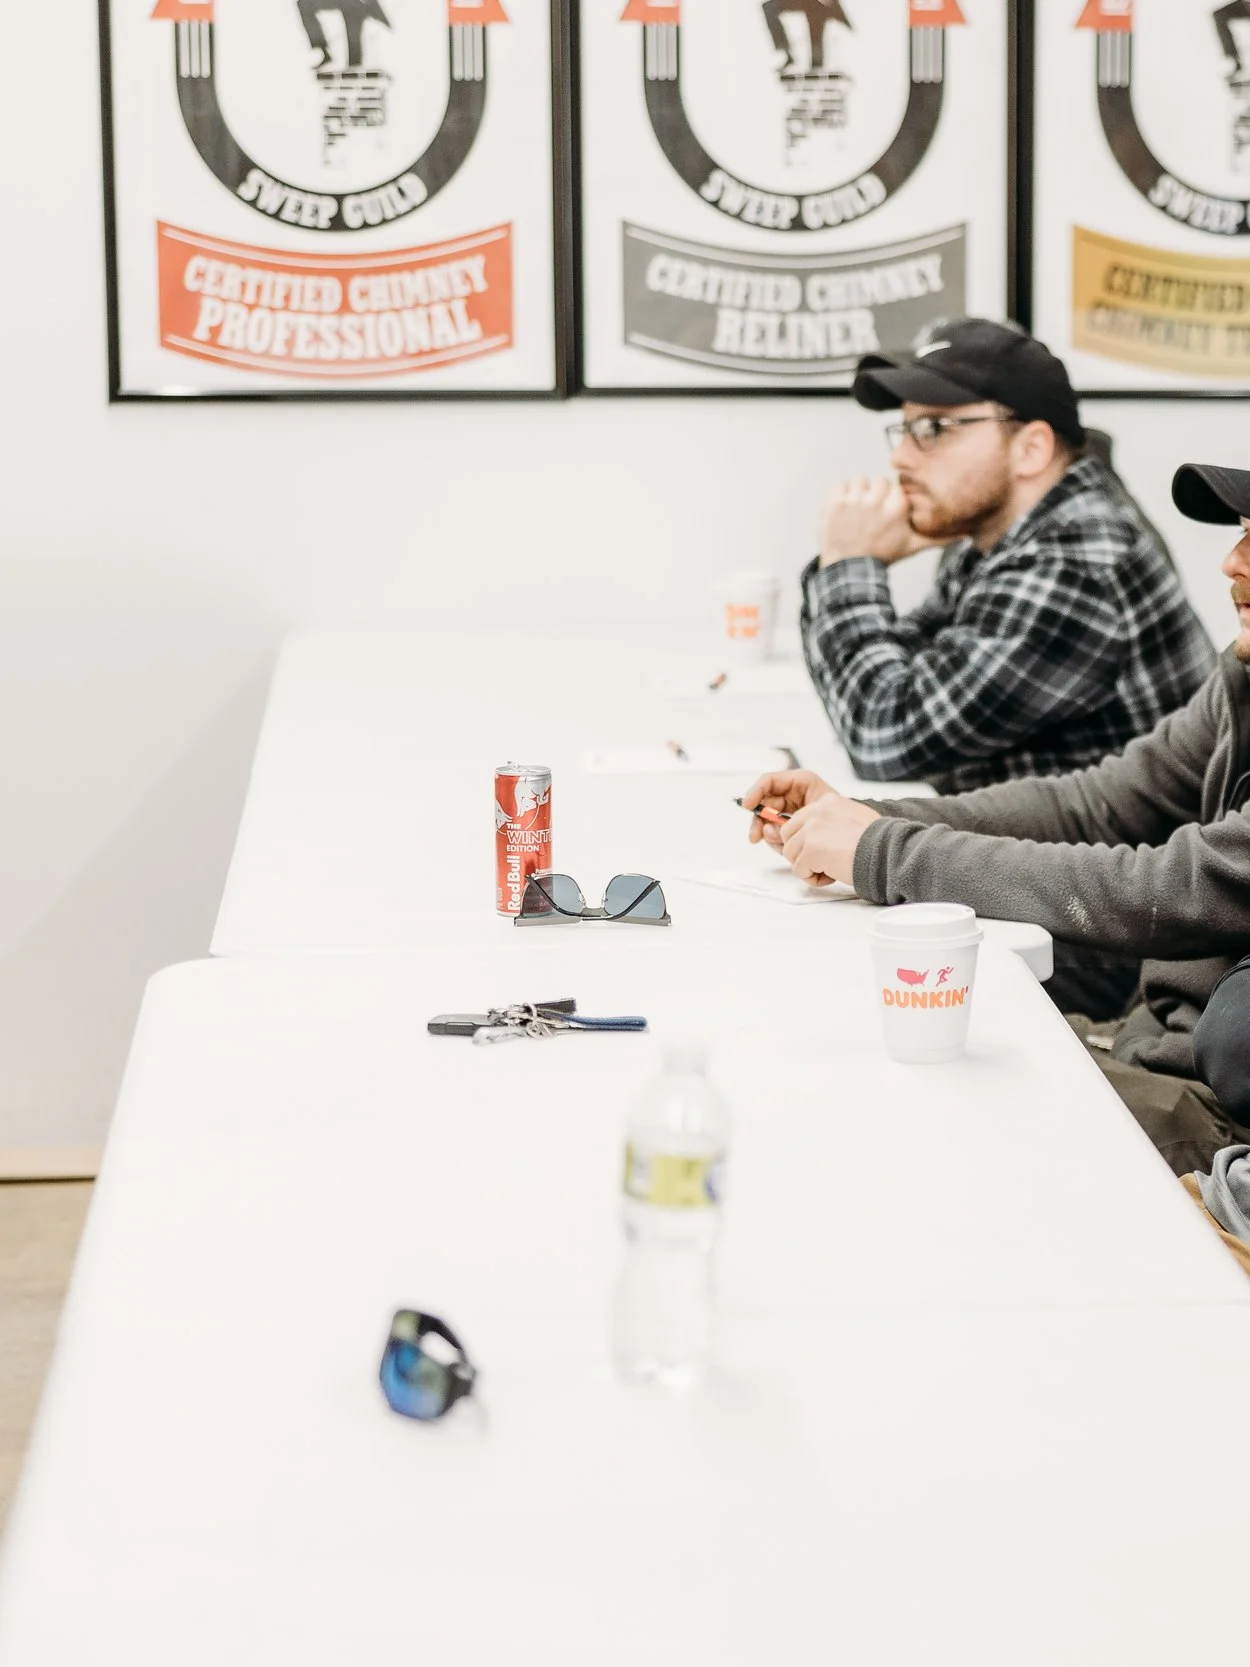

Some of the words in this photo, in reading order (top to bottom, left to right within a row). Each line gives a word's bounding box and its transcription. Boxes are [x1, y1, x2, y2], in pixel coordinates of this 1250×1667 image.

[238, 168, 338, 230] SWEEP
[342, 173, 428, 230] GUILD
[700, 168, 799, 230] SWEEP
[801, 173, 887, 230] GUILD
[1148, 174, 1244, 235] SWEEP
[183, 255, 342, 313] CERTIFIED
[348, 254, 490, 313] CHIMNEY
[645, 254, 802, 312] CERTIFIED
[806, 253, 945, 312] CHIMNEY
[192, 299, 482, 360] PROFESSIONAL
[711, 308, 880, 359] RELINER
[506, 844, 540, 853] EDITION
[882, 986, 969, 1009] DUNKIN'
